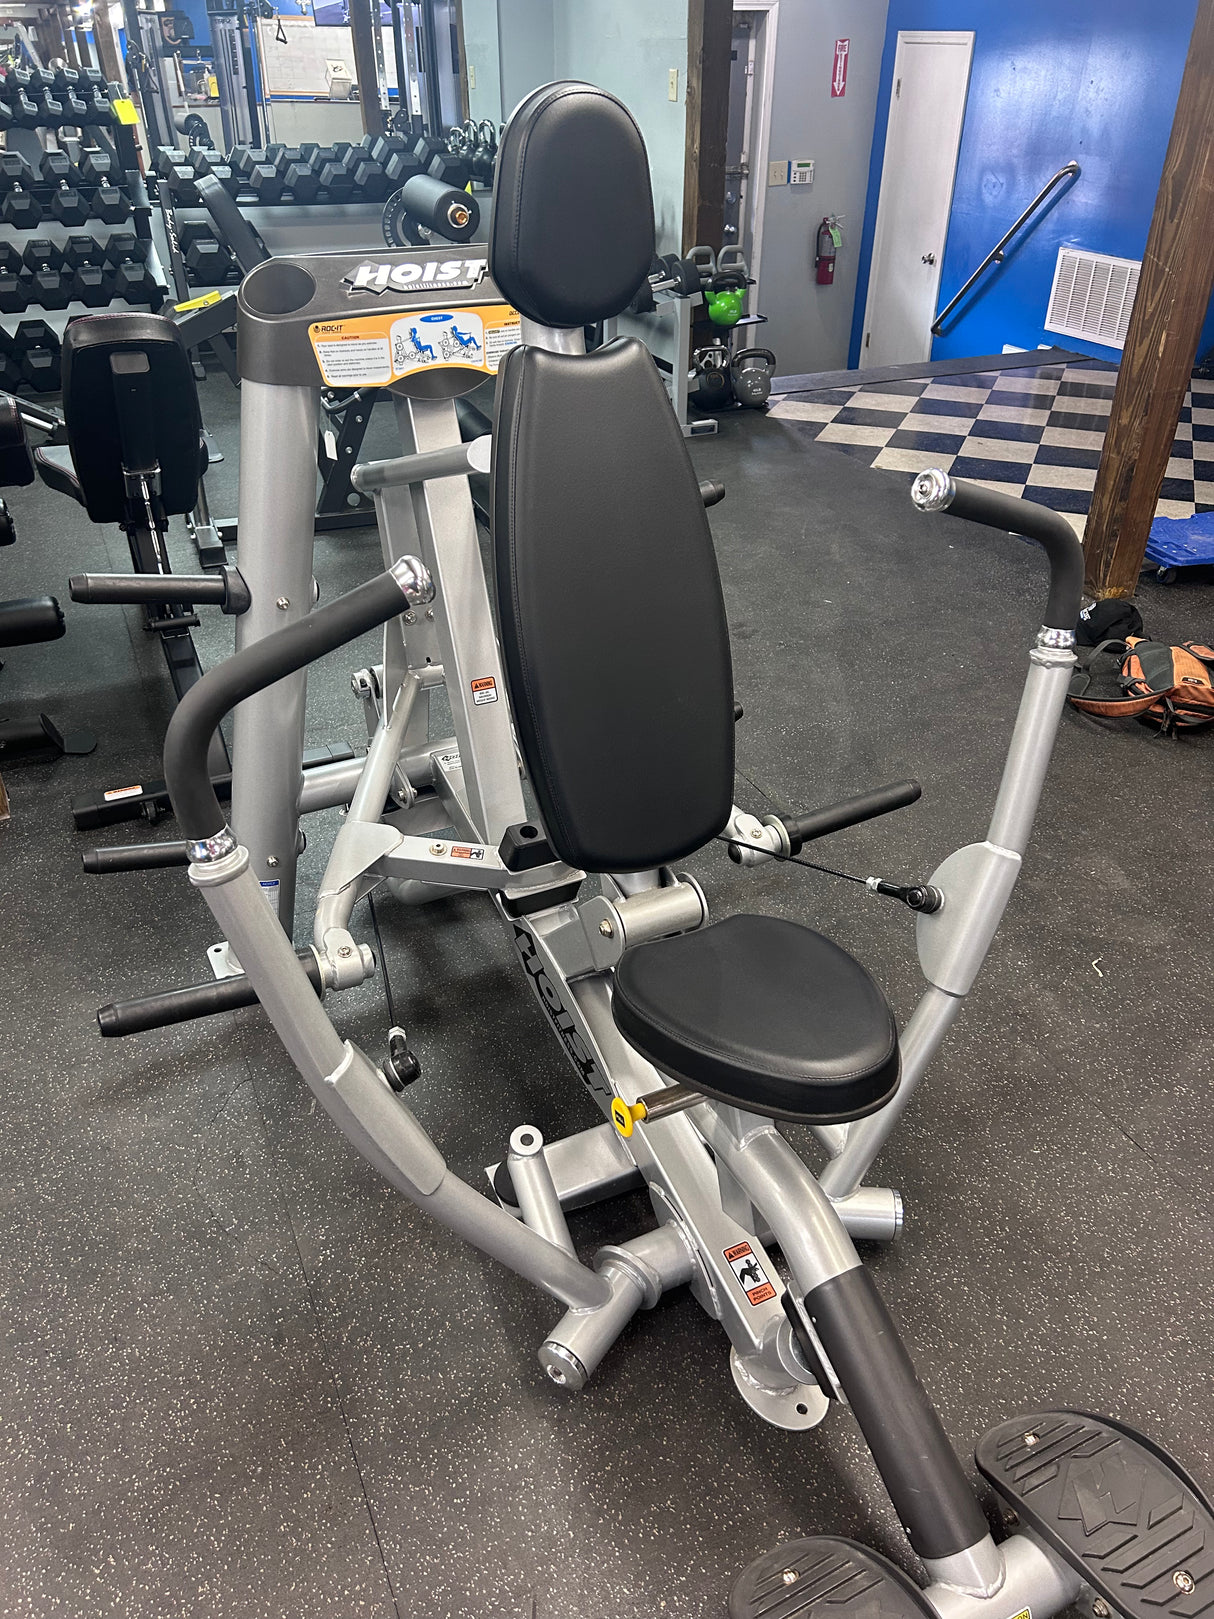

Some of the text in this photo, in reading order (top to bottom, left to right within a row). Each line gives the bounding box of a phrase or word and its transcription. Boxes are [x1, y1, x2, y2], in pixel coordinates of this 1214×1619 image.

[353, 258, 488, 286] HOIST
[514, 926, 611, 1096] HOIST
[752, 1287, 768, 1297] PINCH
[753, 1291, 772, 1302] POINTS
